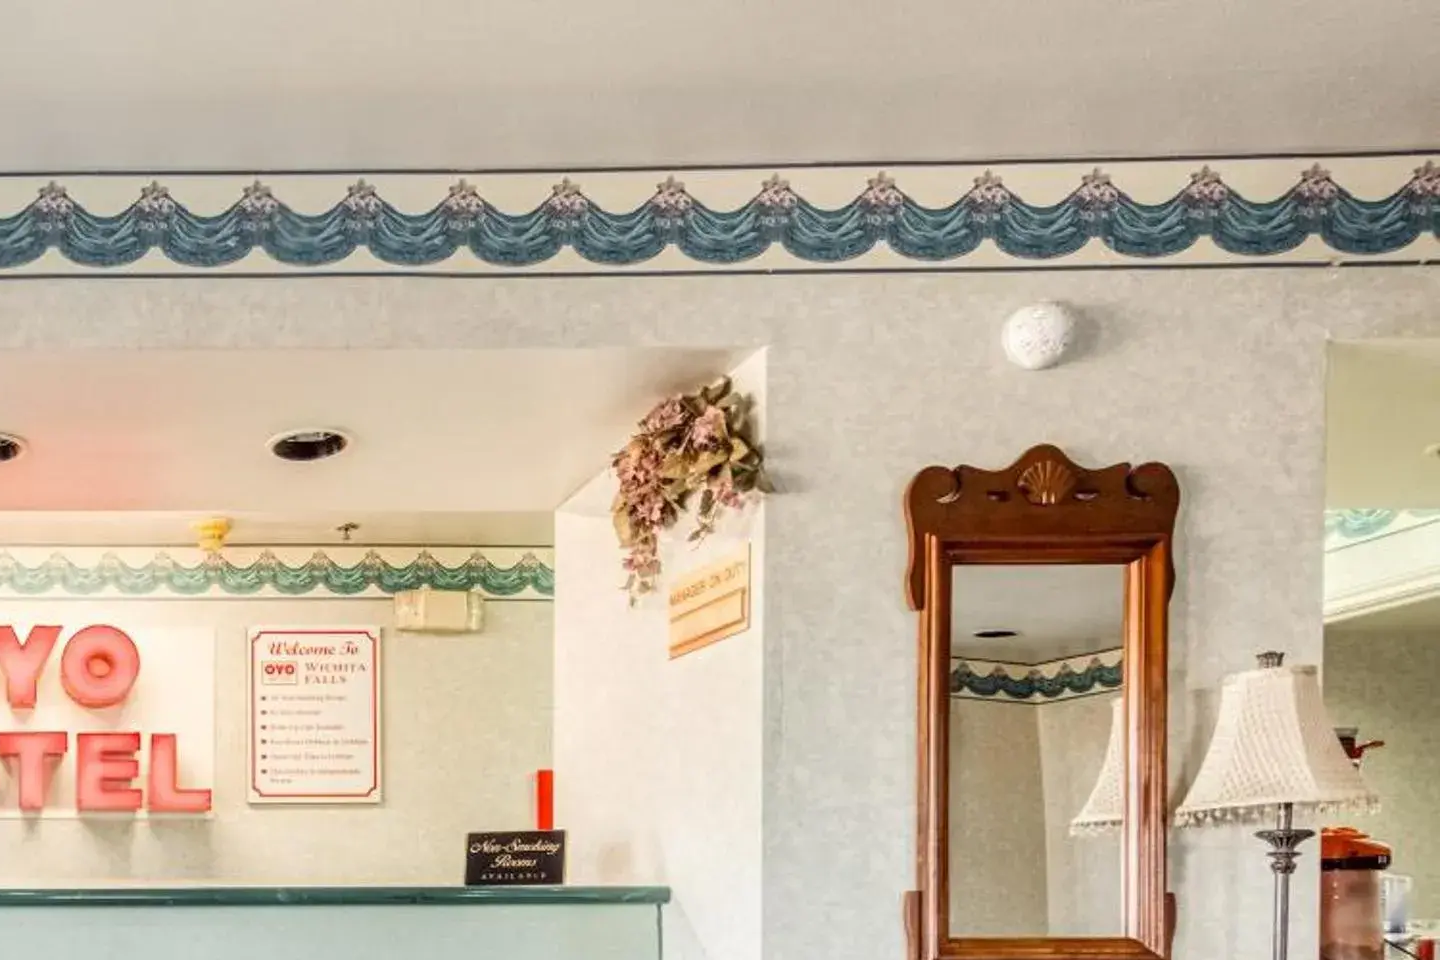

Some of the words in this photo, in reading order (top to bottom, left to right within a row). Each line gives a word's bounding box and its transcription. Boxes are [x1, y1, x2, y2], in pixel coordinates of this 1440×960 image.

[269, 639, 336, 656] Welcome
[339, 640, 359, 656] To
[264, 663, 295, 675] OYO
[470, 838, 561, 857] Non-Smoking
